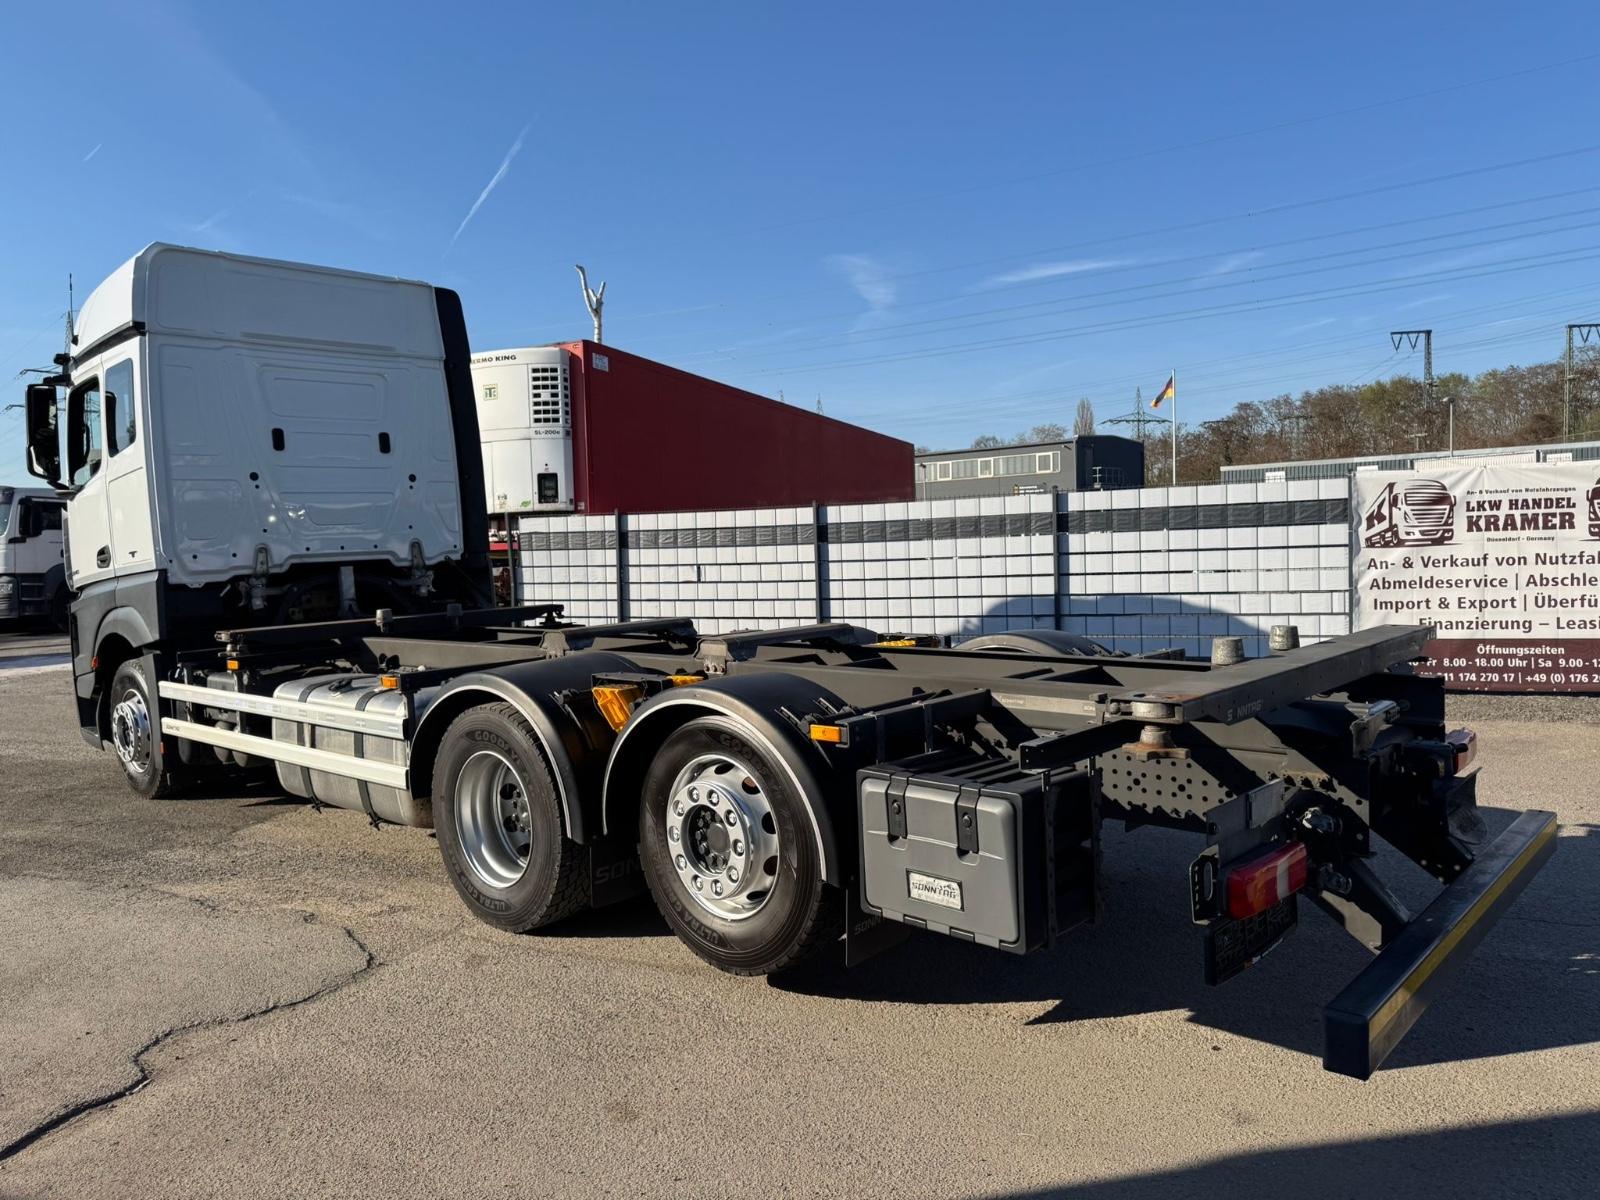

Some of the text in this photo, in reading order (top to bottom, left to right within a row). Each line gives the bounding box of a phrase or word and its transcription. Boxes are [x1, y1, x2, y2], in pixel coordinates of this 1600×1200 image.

[495, 354, 517, 362] KING
[1466, 497, 1576, 512] LKW HANDEL
[1466, 512, 1576, 532] KRAMER
[1367, 551, 1600, 570] An- & Verkauf von Nutzfa
[1369, 574, 1508, 590] Abmeldeservice
[1525, 572, 1598, 587] Abschle
[1373, 598, 1431, 613] Import
[1438, 596, 1450, 609] &
[1457, 596, 1517, 613] Export
[1534, 592, 1598, 608] Überfü
[1419, 617, 1532, 633] Finanzierung
[1476, 643, 1565, 657] Öffnungszeiten
[1443, 658, 1466, 667] 8.00
[1474, 658, 1504, 667] 18.00
[1507, 657, 1528, 667] Uhr
[1538, 658, 1552, 668] Sa
[1558, 658, 1583, 668] 9.00
[1458, 673, 1477, 682] 174
[1480, 673, 1499, 682] 270
[1502, 673, 1515, 682] 17
[1525, 673, 1547, 683] +49
[1550, 672, 1565, 684] (0)
[1569, 674, 1589, 683] 176
[479, 893, 506, 911] ULTRA
[683, 912, 719, 945] ULTRA
